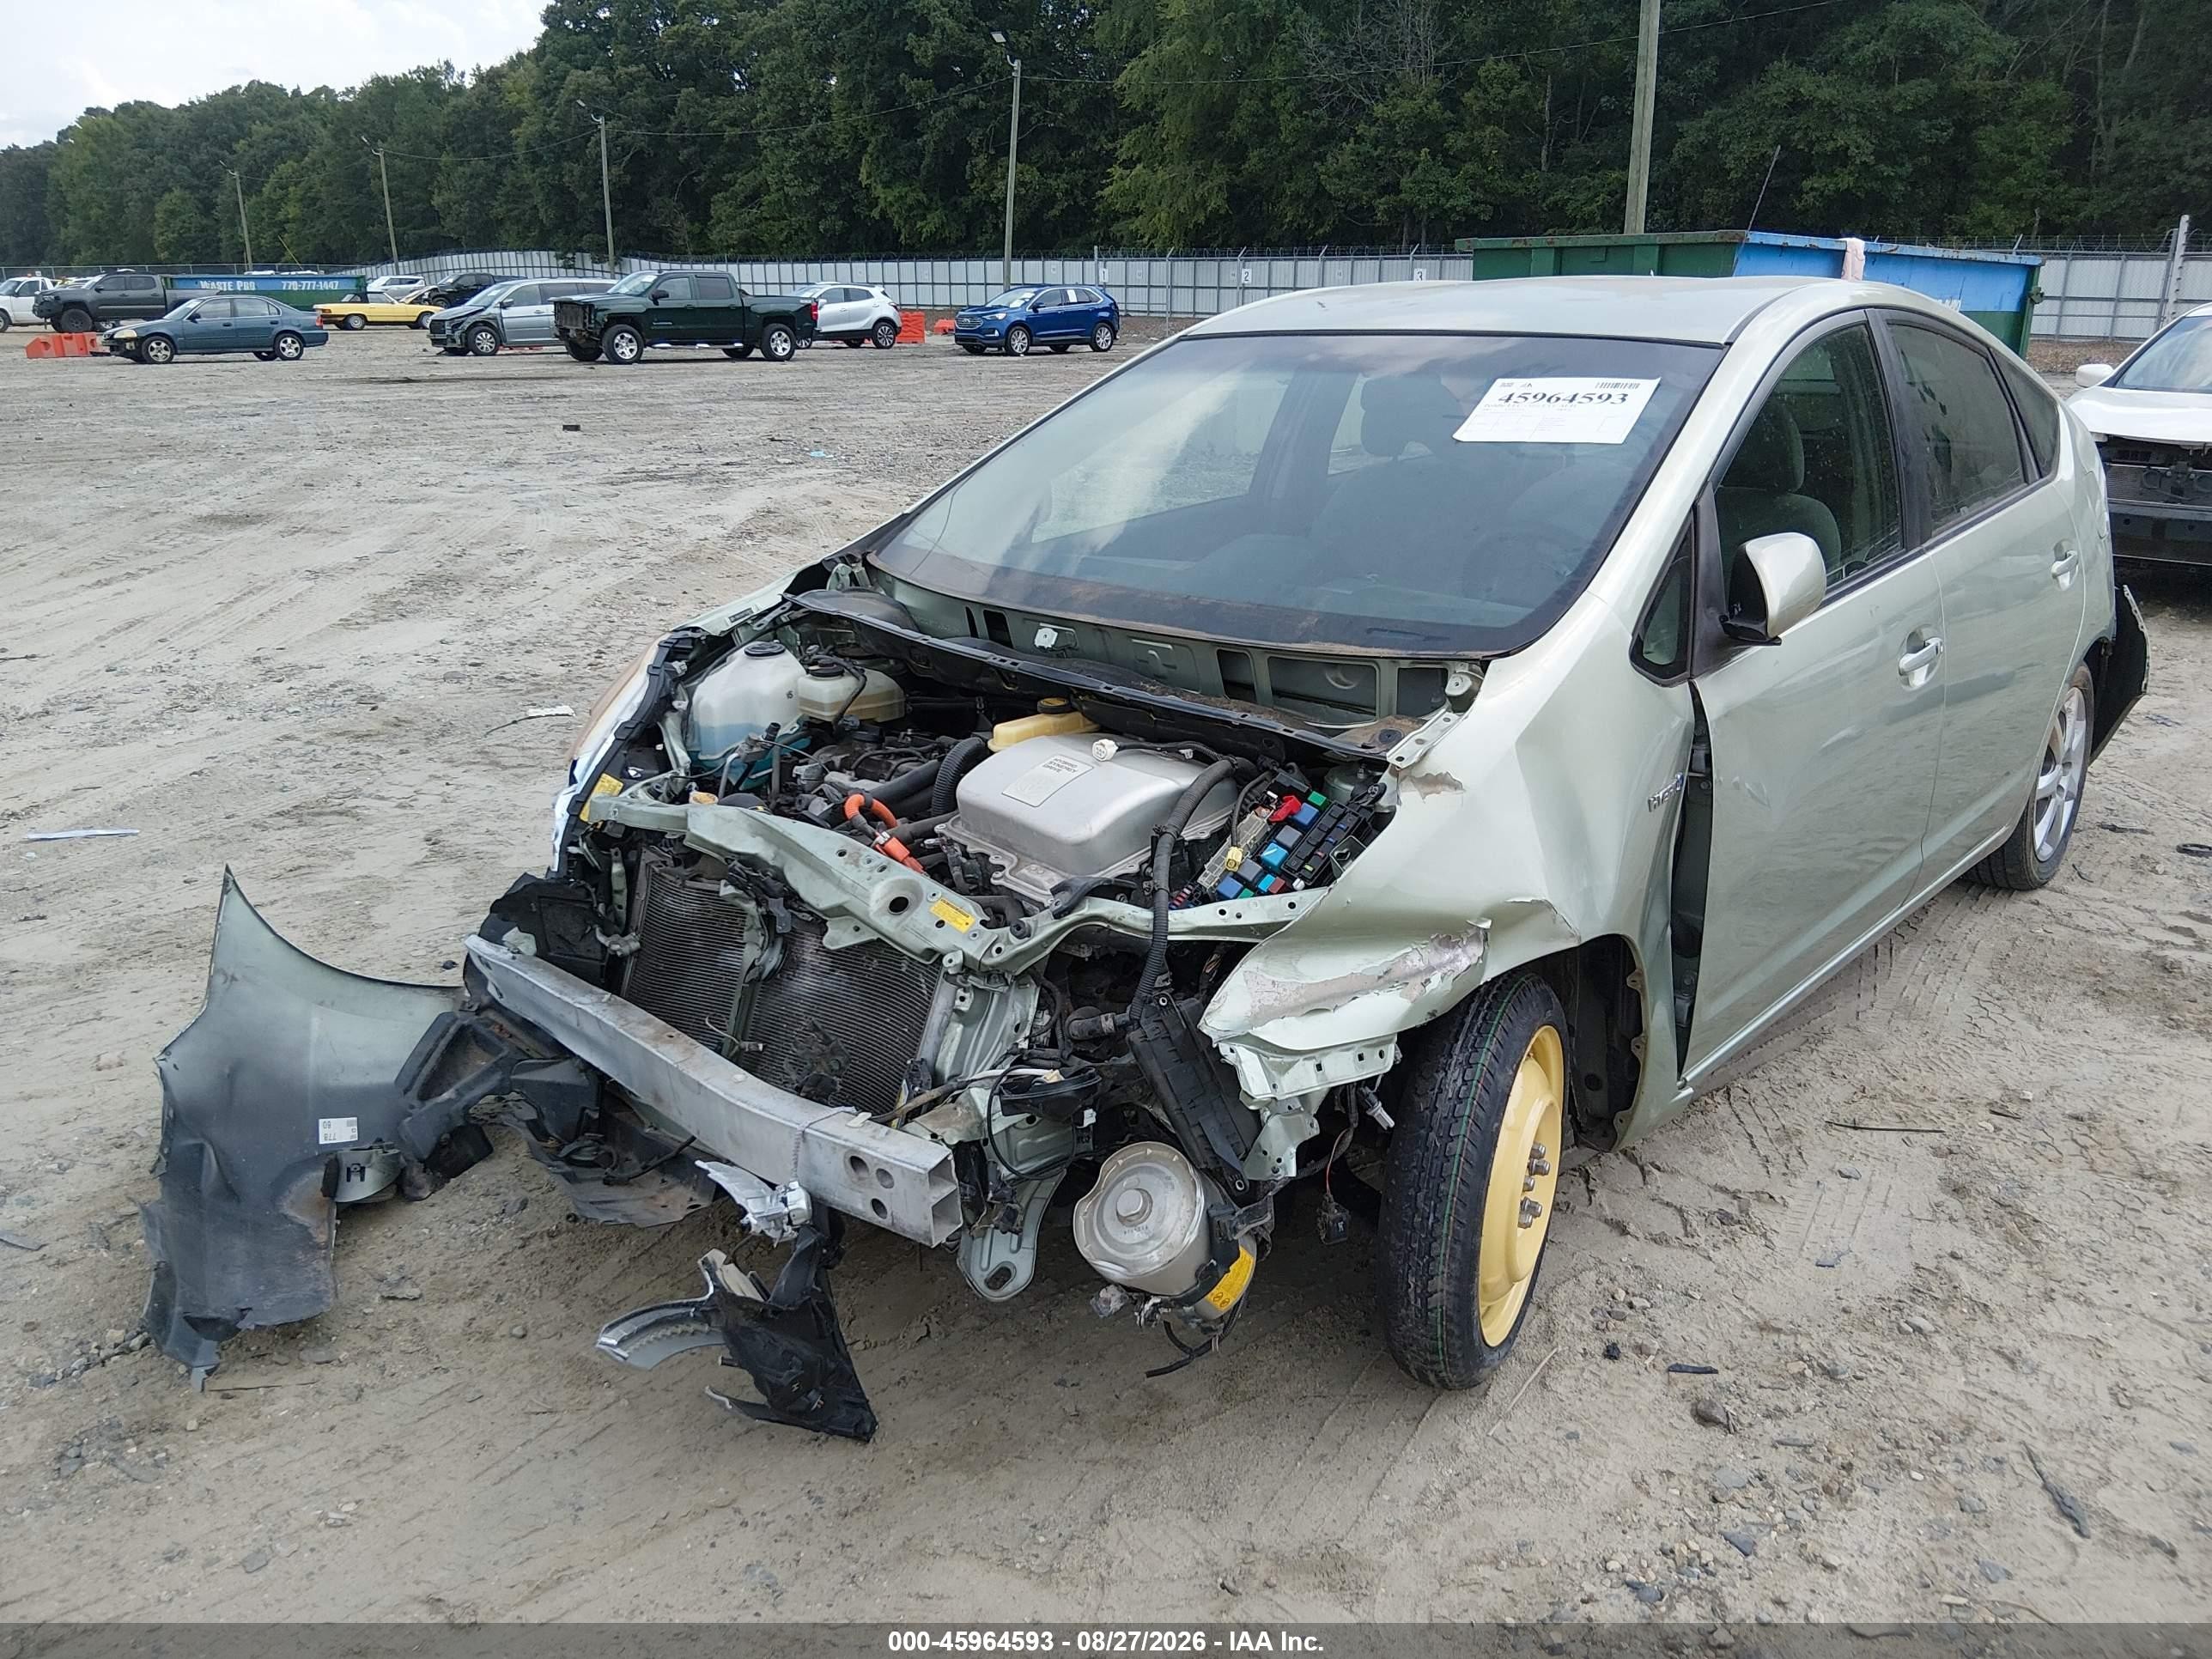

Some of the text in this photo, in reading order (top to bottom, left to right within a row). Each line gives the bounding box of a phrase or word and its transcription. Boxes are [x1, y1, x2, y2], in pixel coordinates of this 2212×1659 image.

[1243, 270, 1249, 282] 2
[1417, 270, 1423, 281] 3
[199, 281, 234, 291] WASTE
[236, 281, 256, 291] PRO
[1498, 392, 1629, 404] 45964593
